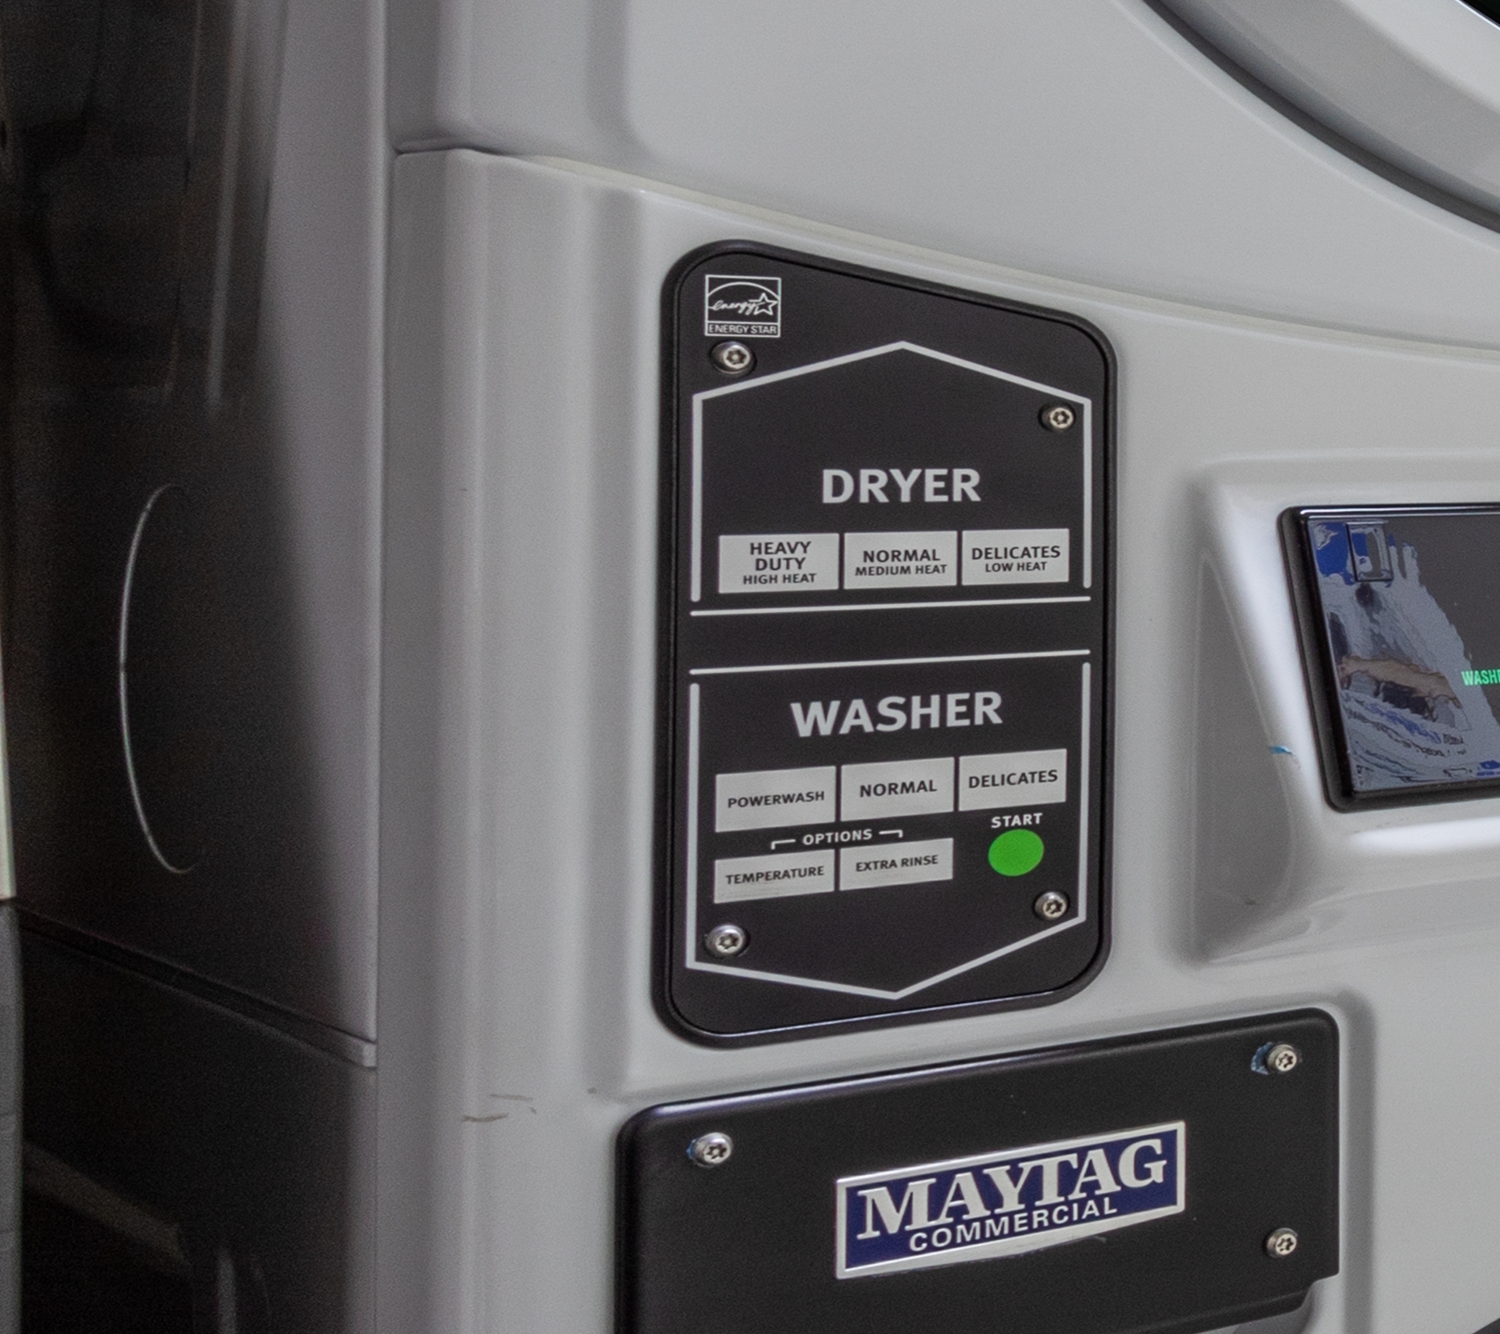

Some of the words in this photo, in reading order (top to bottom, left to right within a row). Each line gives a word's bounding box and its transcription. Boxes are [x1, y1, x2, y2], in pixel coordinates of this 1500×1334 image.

[708, 324, 749, 334] ENERGY
[750, 325, 777, 334] STAR
[821, 467, 982, 504] DRYER
[749, 541, 812, 556] HEAVY
[862, 548, 941, 564] NORMAL
[971, 545, 1061, 561] DELICATES
[754, 556, 808, 572] DUTY
[855, 564, 912, 577] MEDIUM
[915, 563, 948, 575] HEAT
[984, 562, 1012, 573] LOW
[1013, 561, 1048, 572] HEAT
[742, 574, 779, 586] HIGH
[782, 572, 817, 584] HEAT
[789, 690, 1003, 738] WASHER
[968, 769, 1059, 789] DELICATES
[859, 779, 938, 798] NORMAL
[727, 790, 825, 809] POWERWASH
[991, 813, 1043, 828] START
[802, 829, 873, 846] OPTIONS
[855, 858, 898, 873] EXTRA
[900, 854, 939, 868] RINSE
[725, 865, 825, 885] TEMPERATURE
[856, 1138, 1168, 1241] MAYTAG
[908, 1198, 1118, 1253] COMMERCIAL
